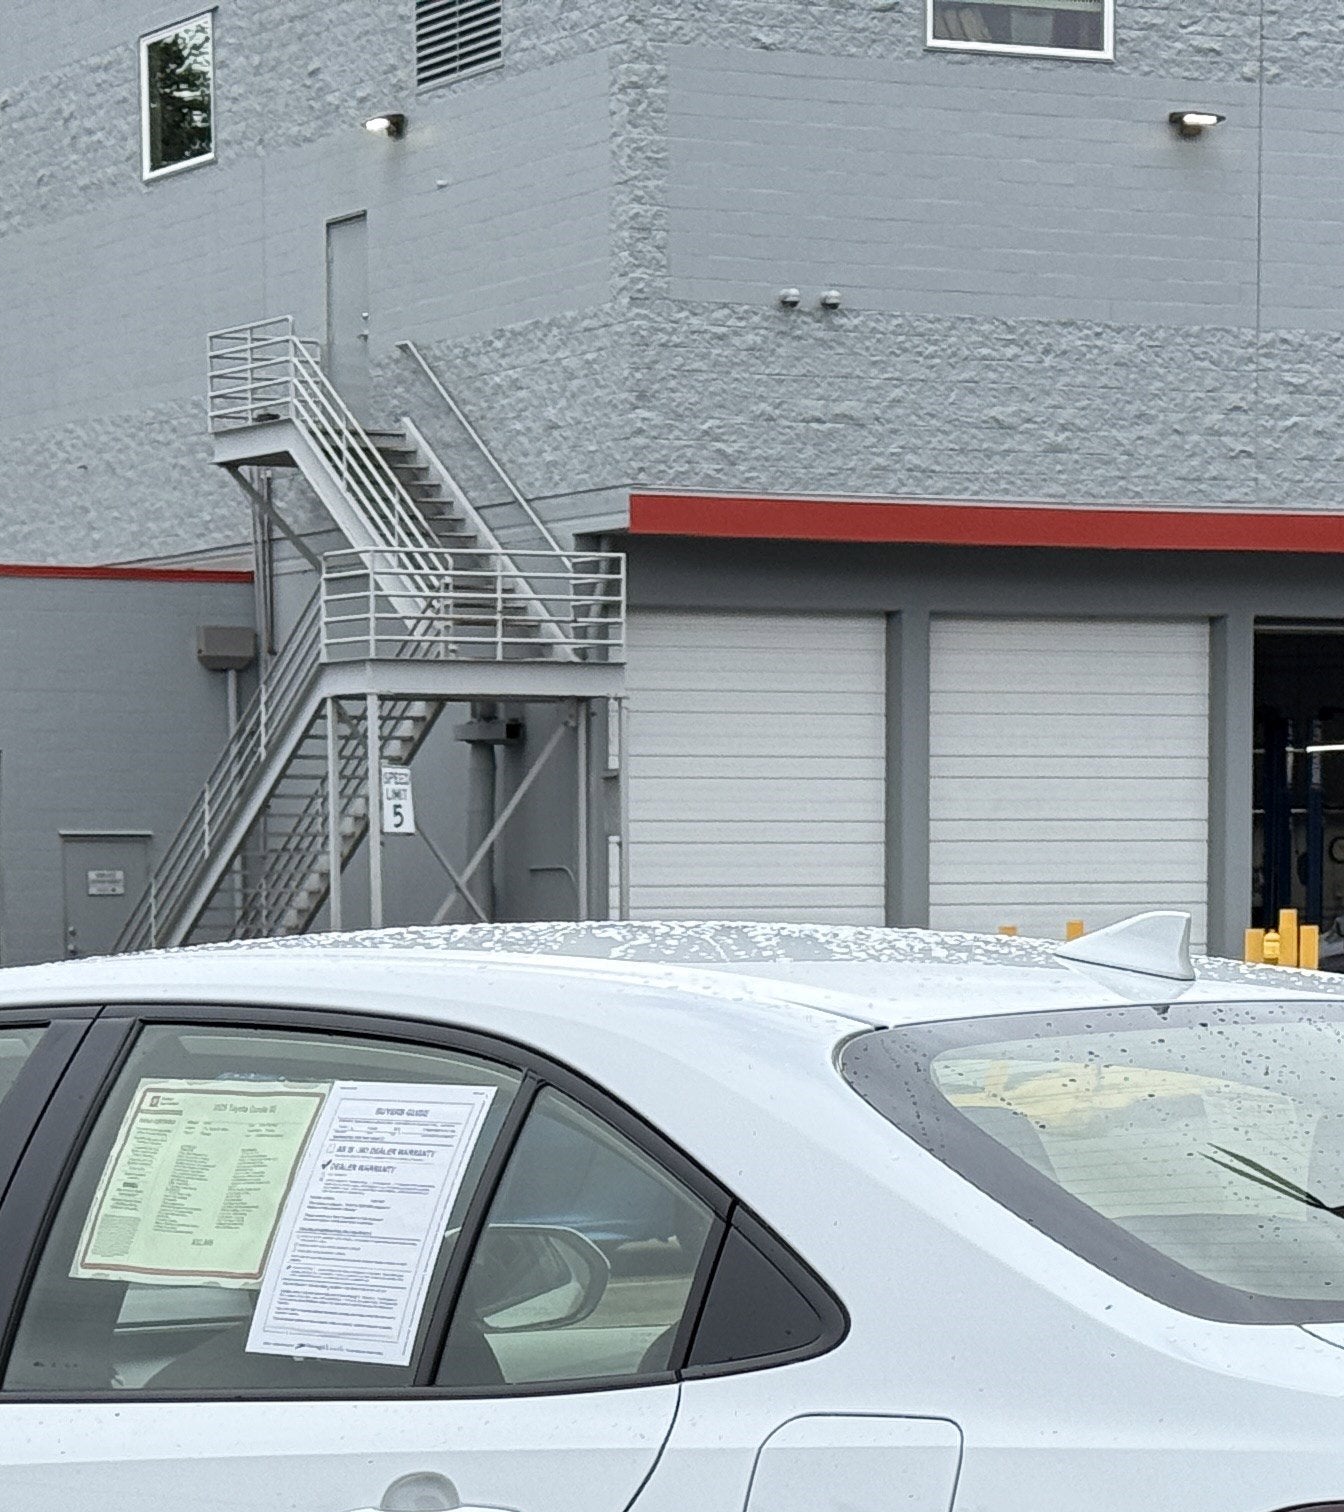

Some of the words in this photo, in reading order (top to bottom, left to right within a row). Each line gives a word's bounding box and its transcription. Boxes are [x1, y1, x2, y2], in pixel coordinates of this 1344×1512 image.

[383, 771, 410, 786] SPEED
[385, 787, 408, 801] LIMIT
[393, 803, 405, 828] 5
